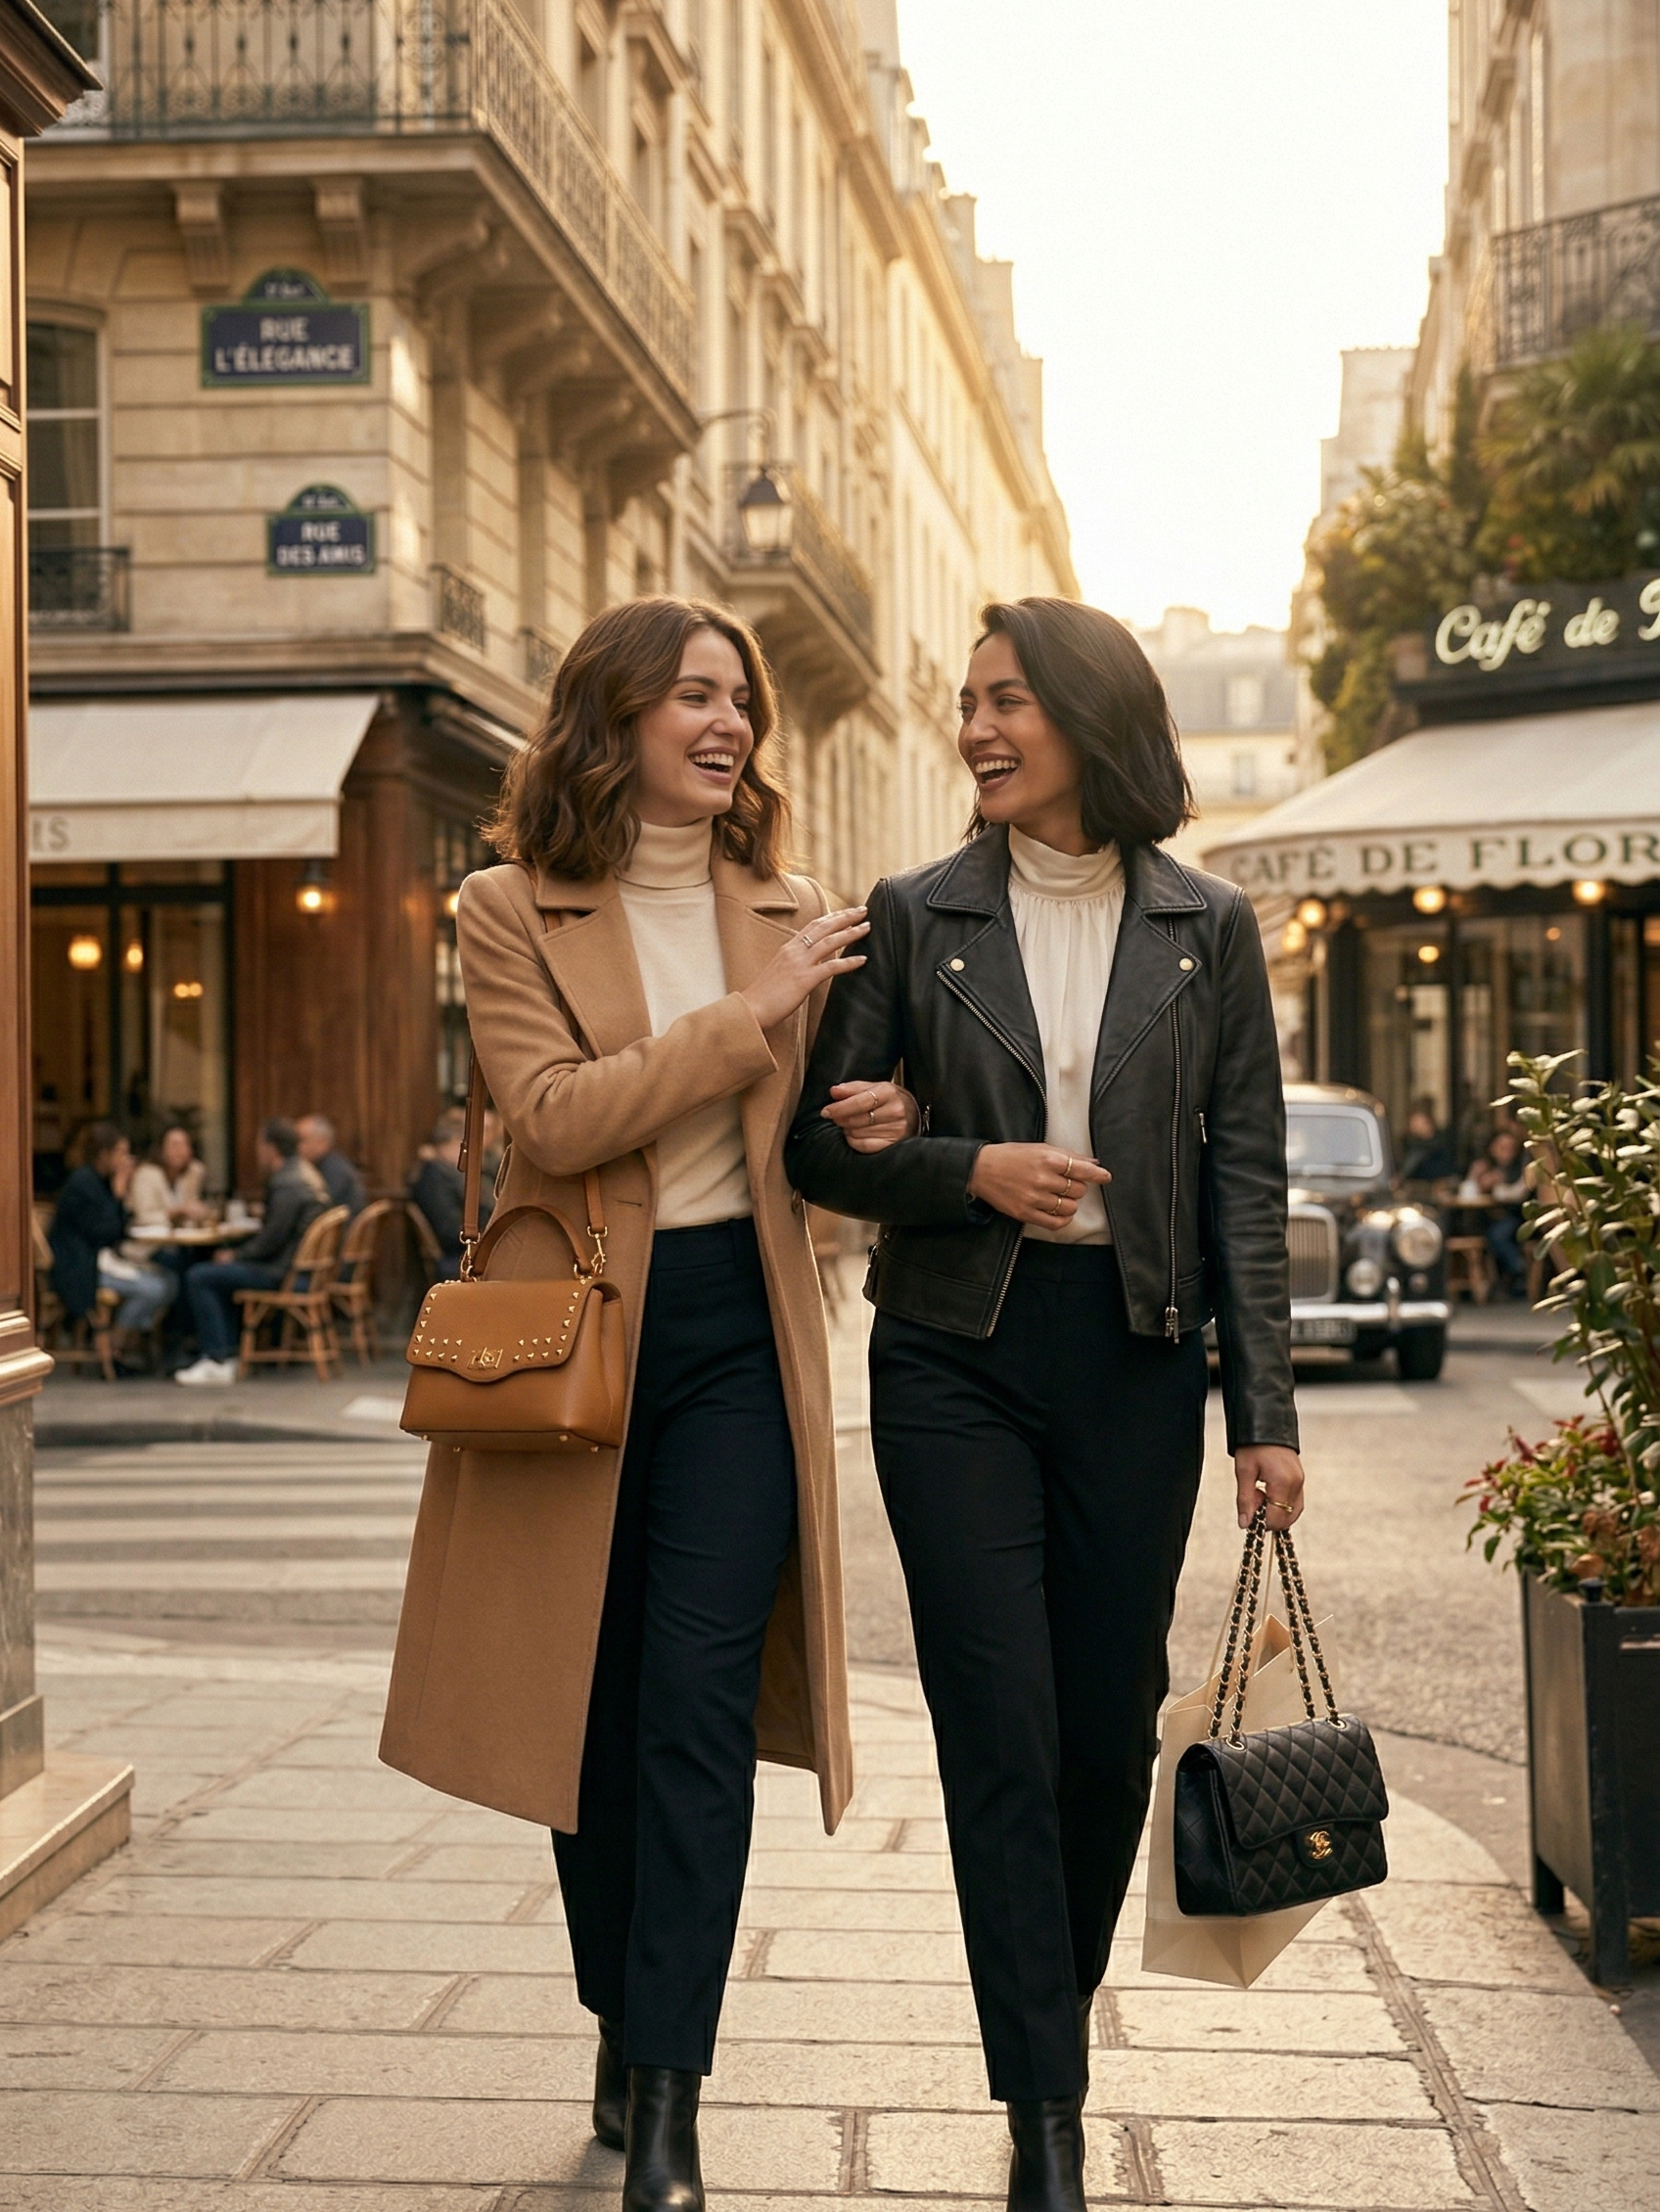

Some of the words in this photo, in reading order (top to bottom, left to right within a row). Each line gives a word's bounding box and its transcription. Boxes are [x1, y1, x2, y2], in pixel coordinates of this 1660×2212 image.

[259, 316, 309, 343] RUE
[300, 521, 342, 543] RUE
[276, 544, 316, 568] DES
[1436, 598, 1552, 672] Café
[1564, 596, 1620, 649] de
[1230, 839, 1334, 882] CAFÉ
[1360, 840, 1438, 875] DE
[1470, 833, 1660, 870] FLOR
